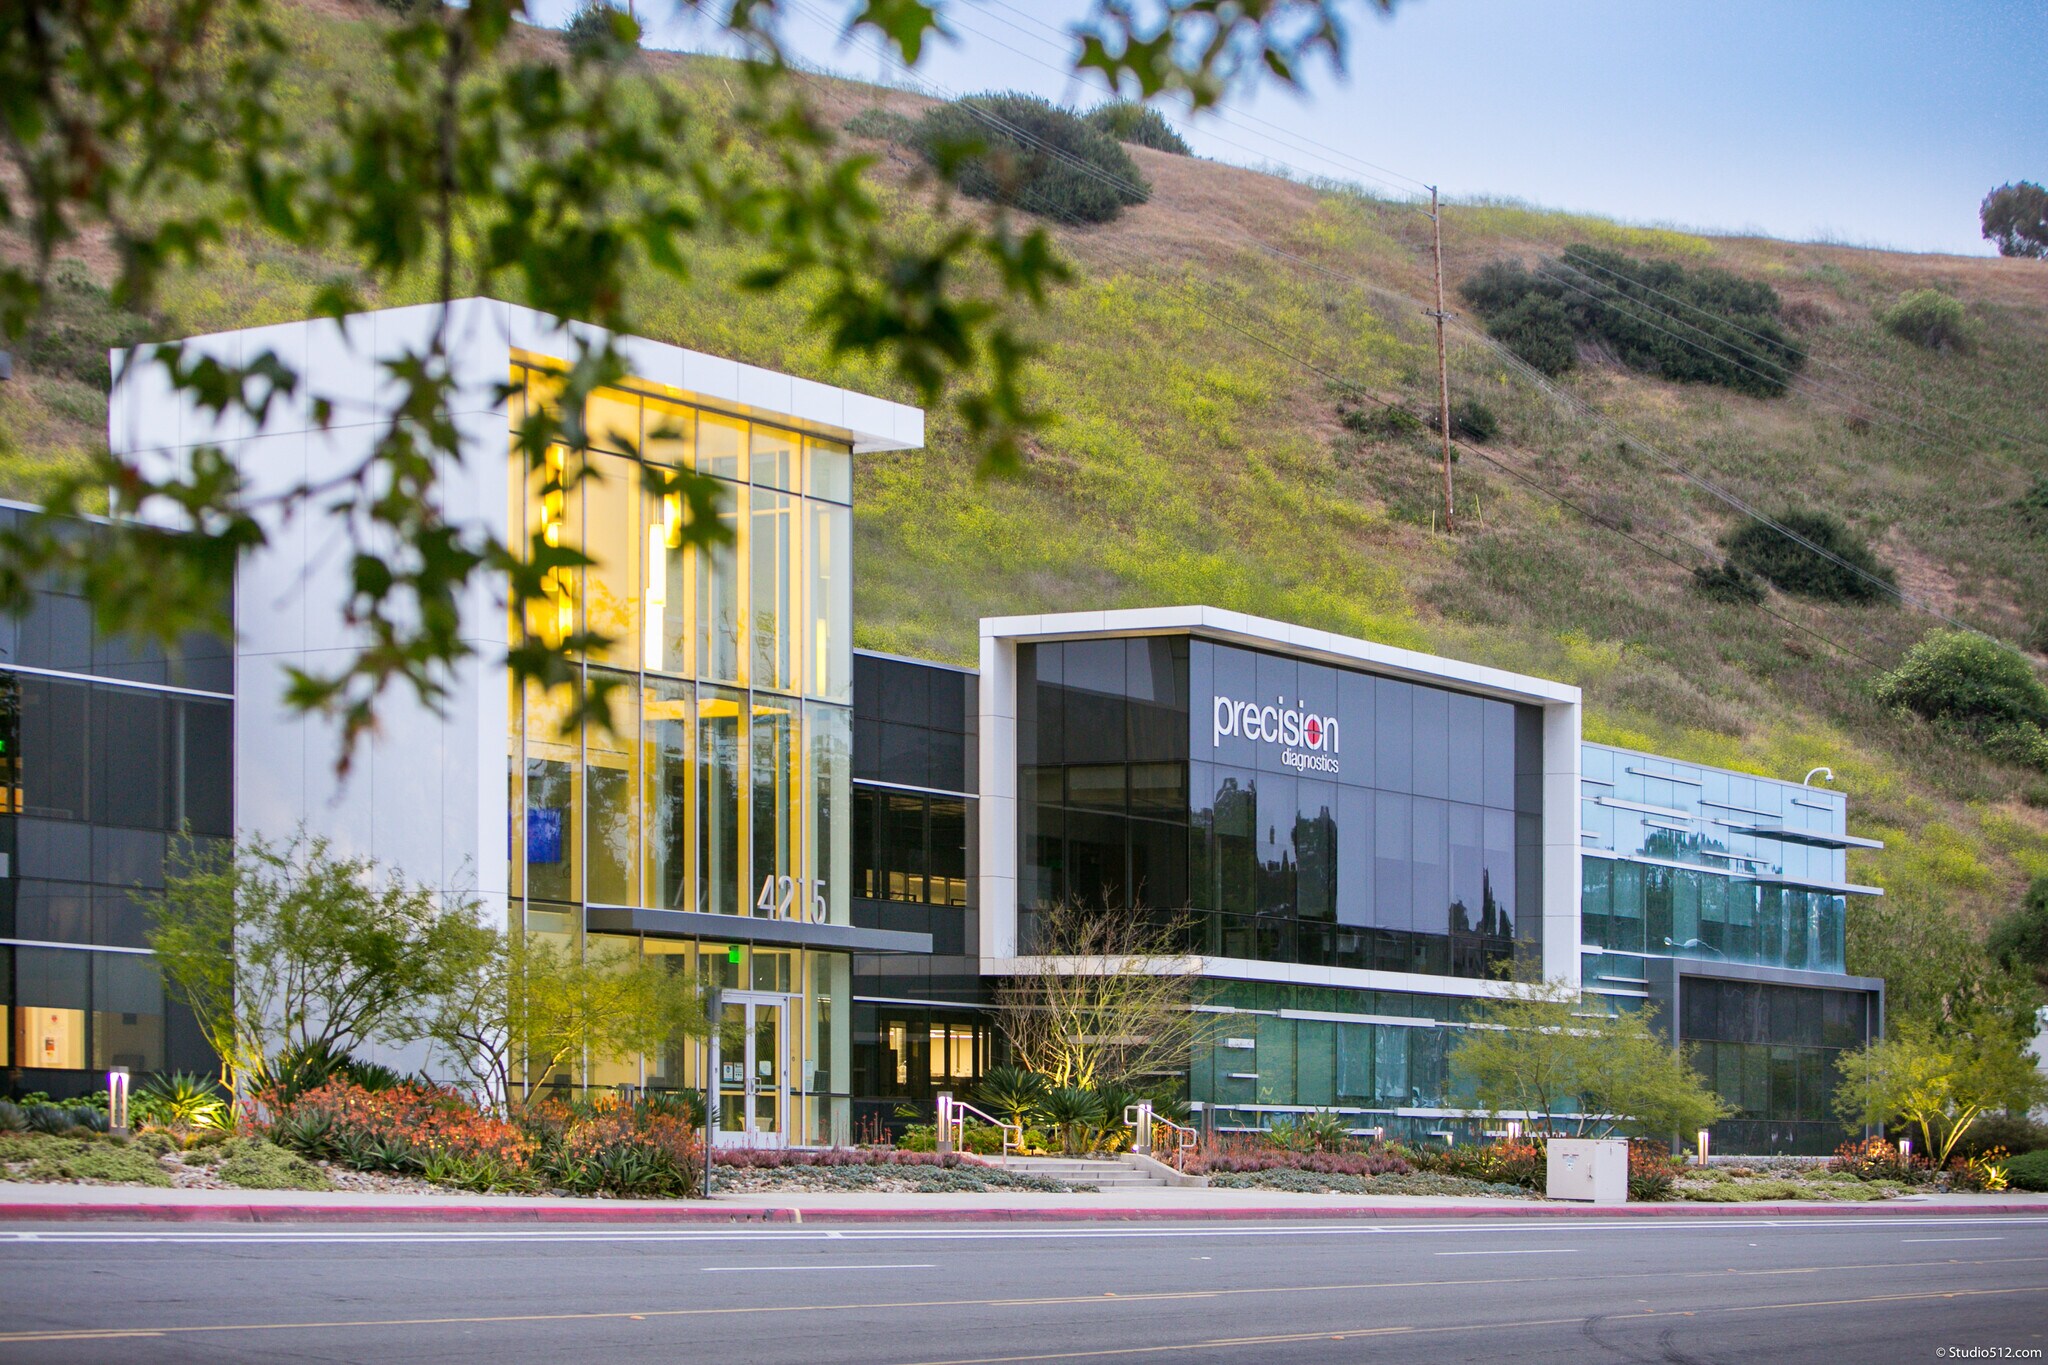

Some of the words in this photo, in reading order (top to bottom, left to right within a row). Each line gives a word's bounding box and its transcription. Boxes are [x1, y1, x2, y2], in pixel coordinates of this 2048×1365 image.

[1213, 695, 1339, 753] precision
[1281, 747, 1339, 773] diagnostics
[757, 874, 826, 925] 4215
